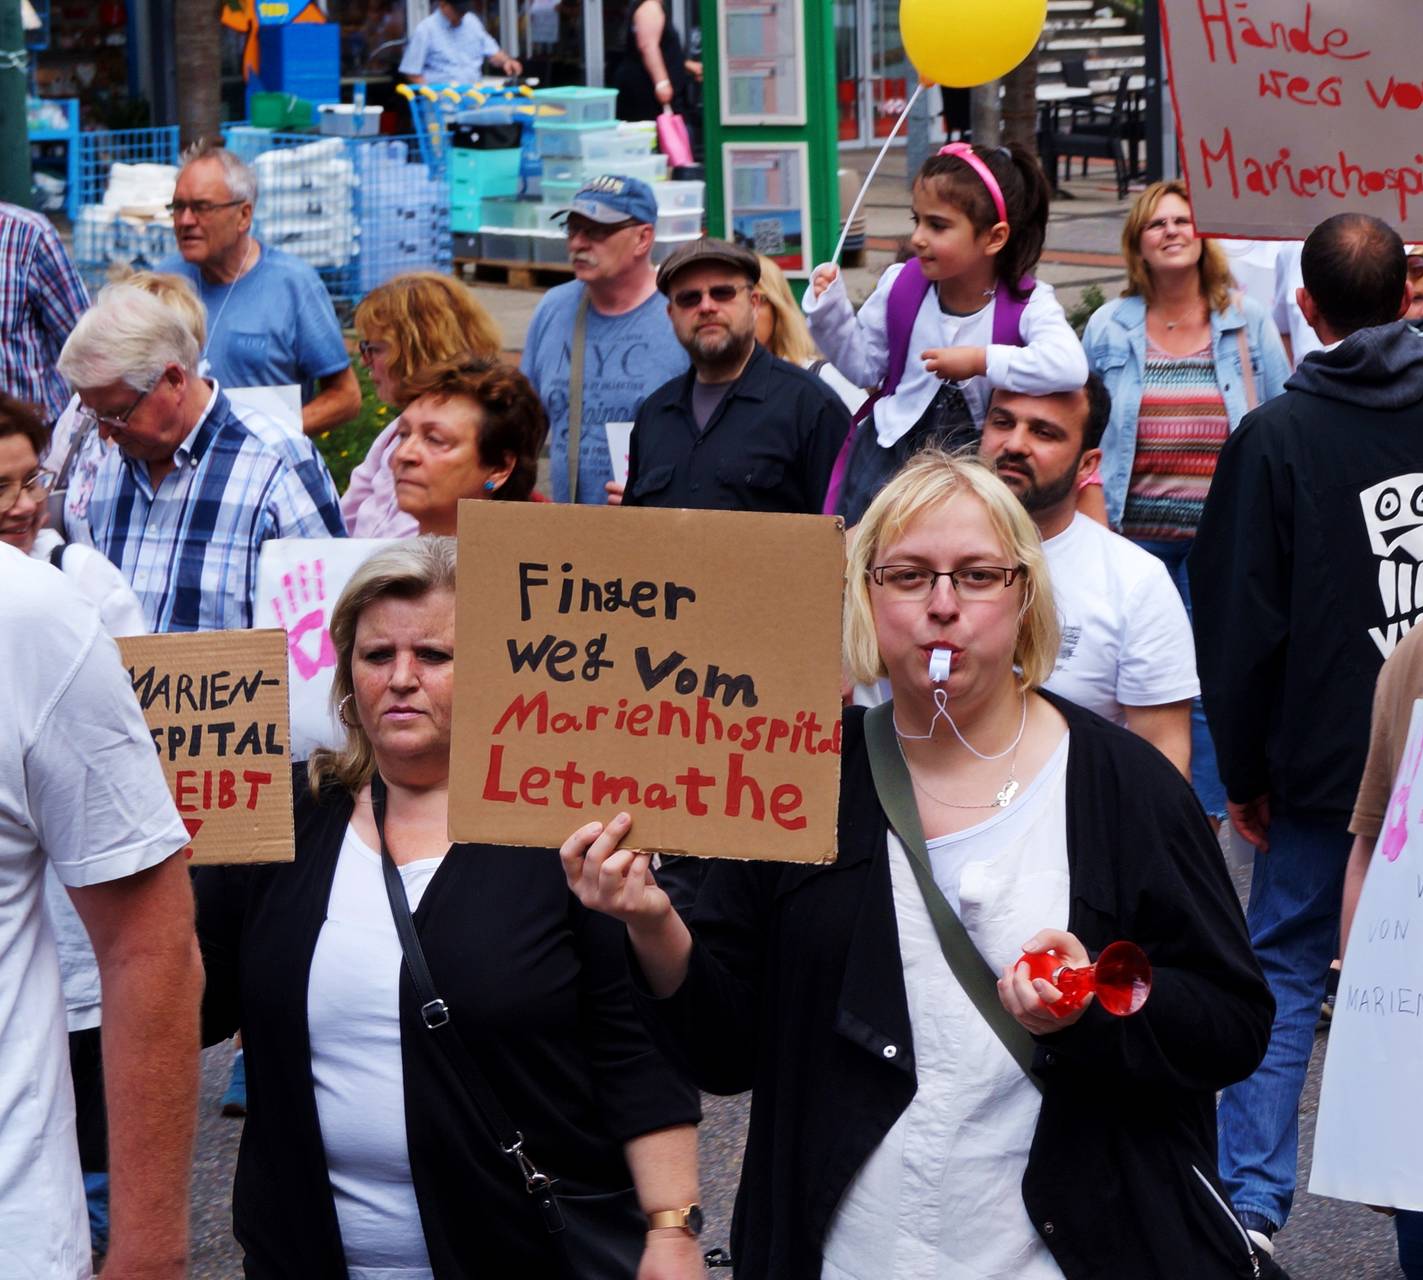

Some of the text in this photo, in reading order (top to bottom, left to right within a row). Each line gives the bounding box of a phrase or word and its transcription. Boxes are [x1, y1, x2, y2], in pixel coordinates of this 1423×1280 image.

[1197, 0, 1371, 64] Hände
[519, 562, 697, 622] Finger
[128, 666, 281, 714] MARIEN-
[492, 691, 841, 755] Marienhospital
[482, 744, 807, 831] Letmathe
[1368, 918, 1411, 946] VON
